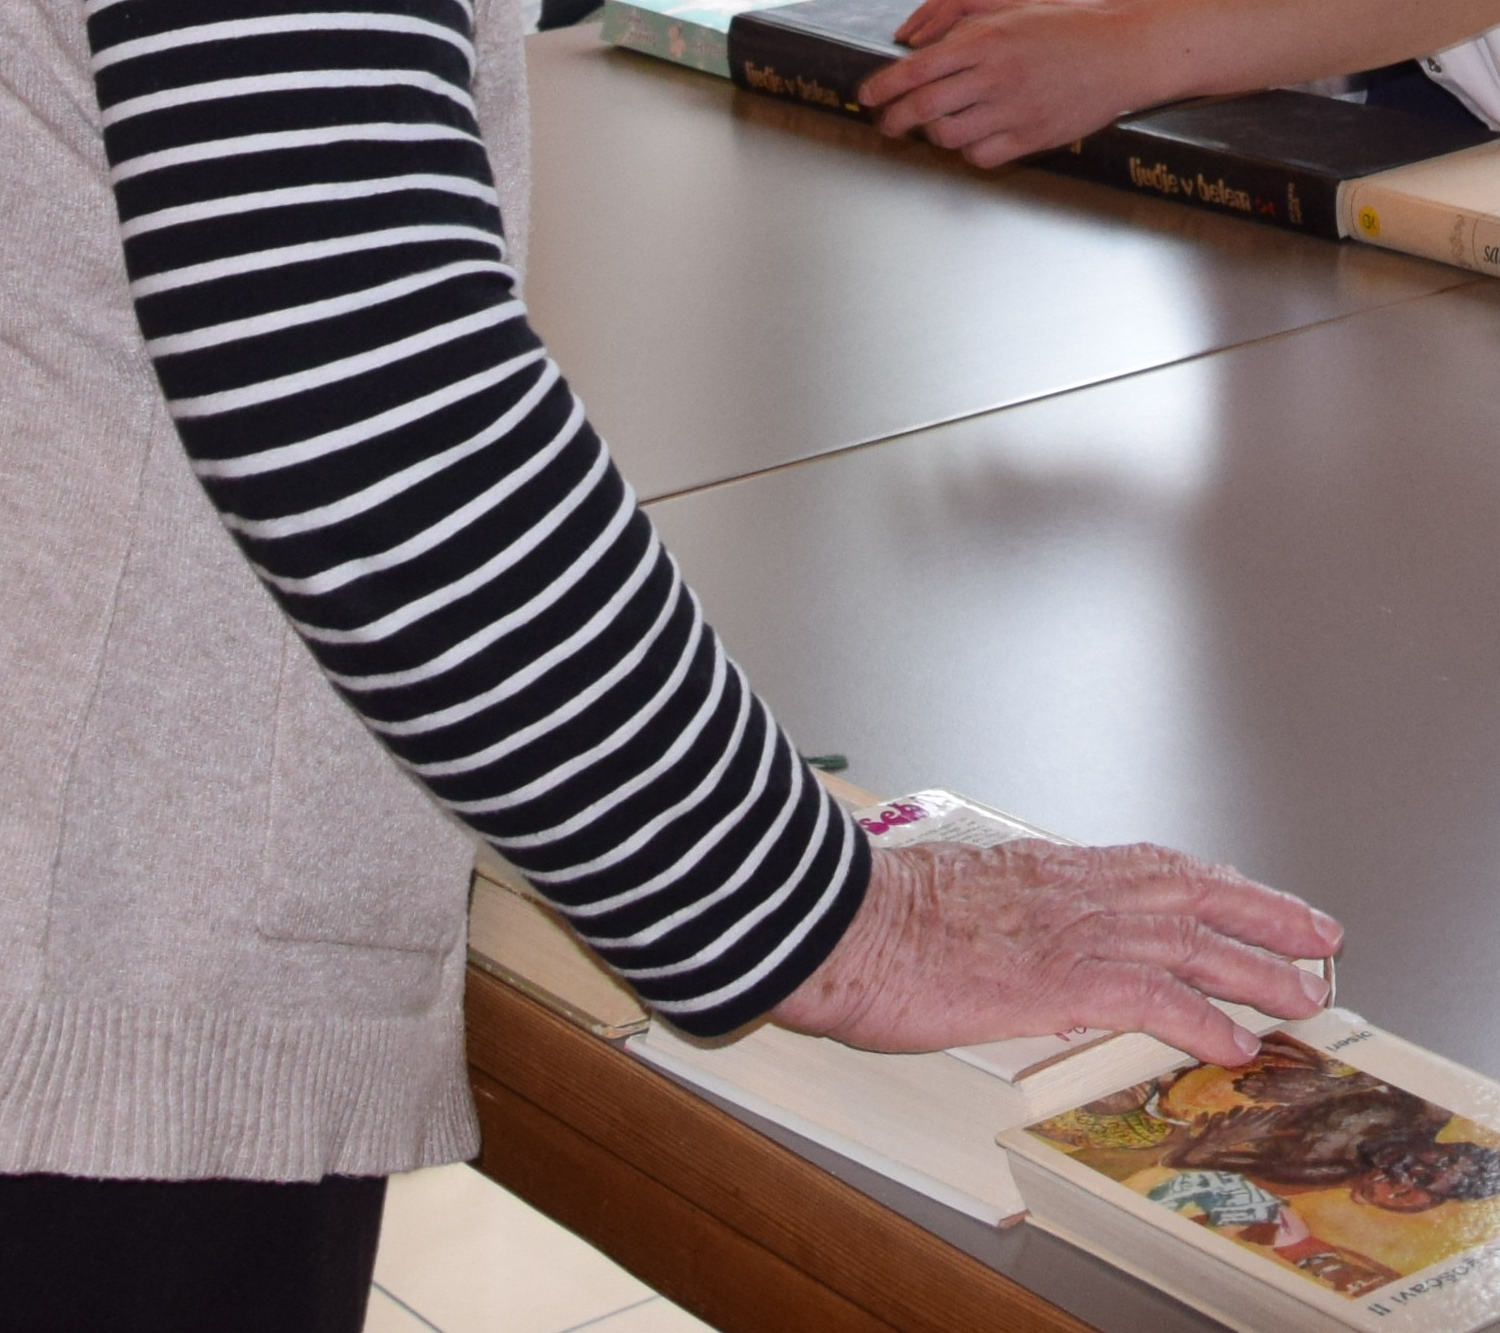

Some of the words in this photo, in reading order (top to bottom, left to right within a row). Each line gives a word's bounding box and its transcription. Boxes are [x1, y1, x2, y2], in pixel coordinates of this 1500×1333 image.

[1129, 156, 1179, 194] ljudje
[1180, 177, 1193, 197] v
[1198, 173, 1251, 211] belem
